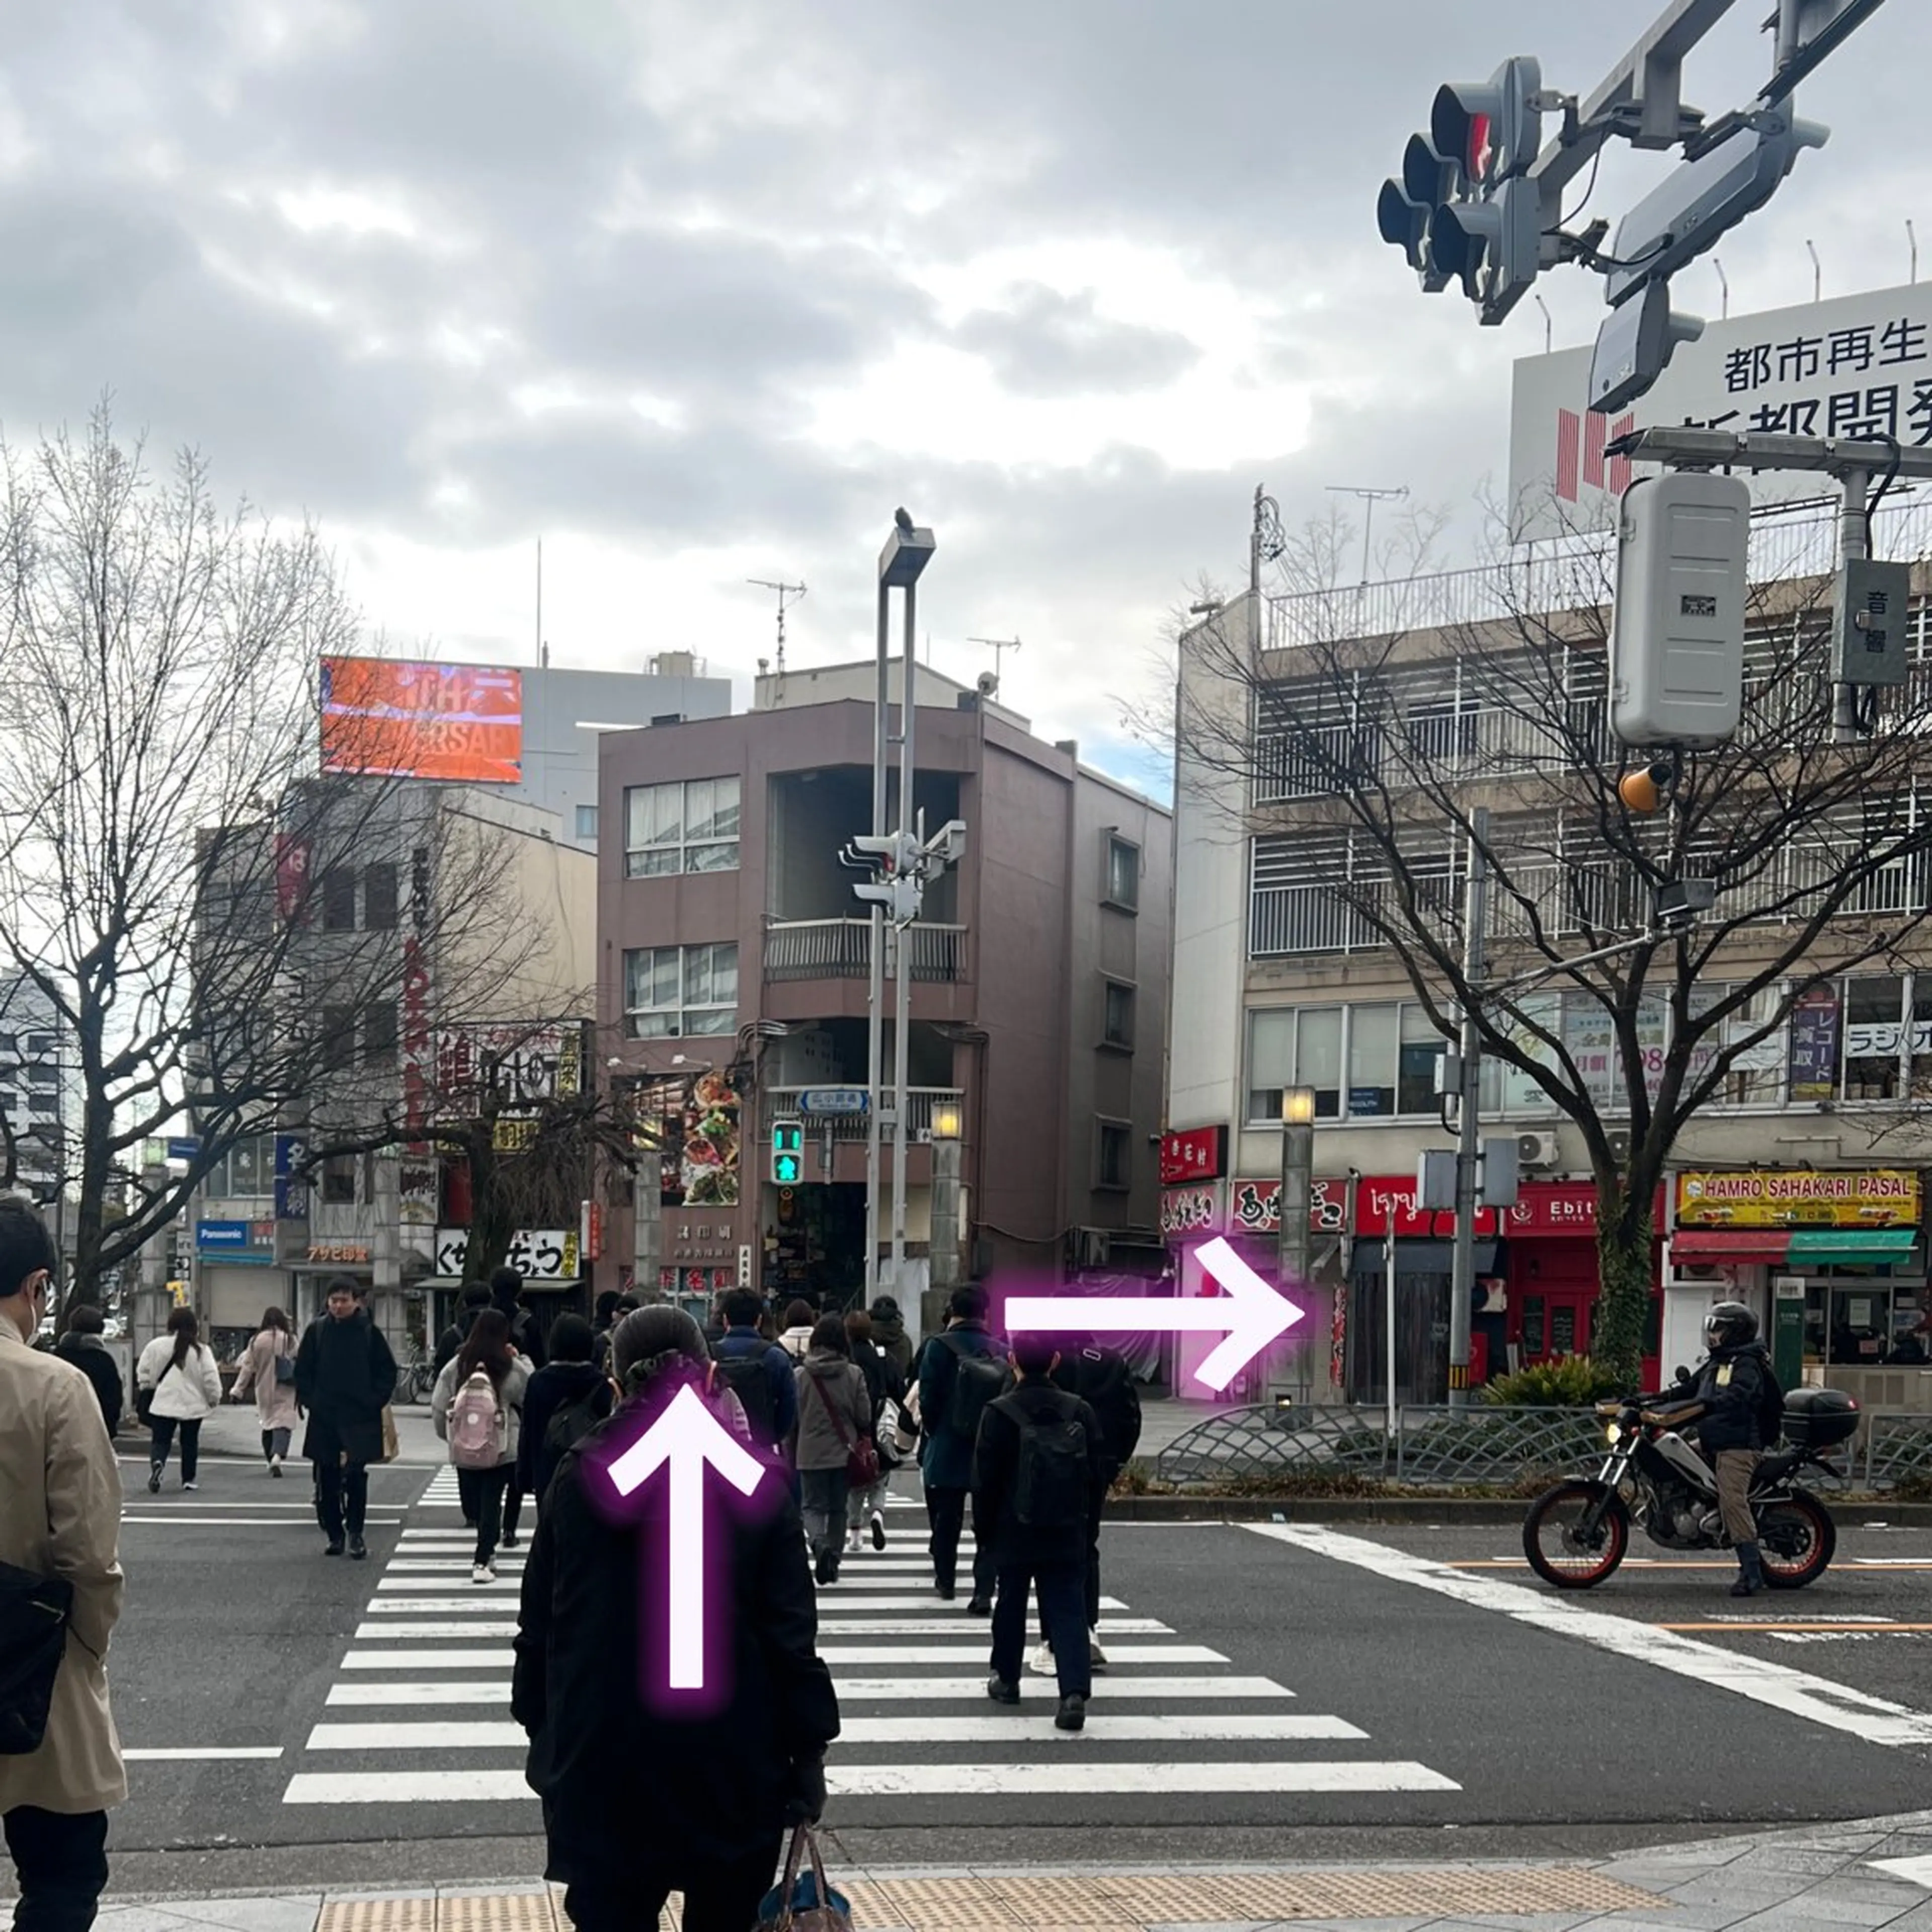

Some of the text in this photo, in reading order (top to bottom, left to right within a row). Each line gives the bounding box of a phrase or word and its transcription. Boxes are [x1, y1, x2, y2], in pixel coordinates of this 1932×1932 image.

[1725, 318, 1927, 393] 都市再生
[1816, 1011, 1835, 1081] レコード
[1705, 1177, 1911, 1197] HAMRO SAHAKARI PASAL
